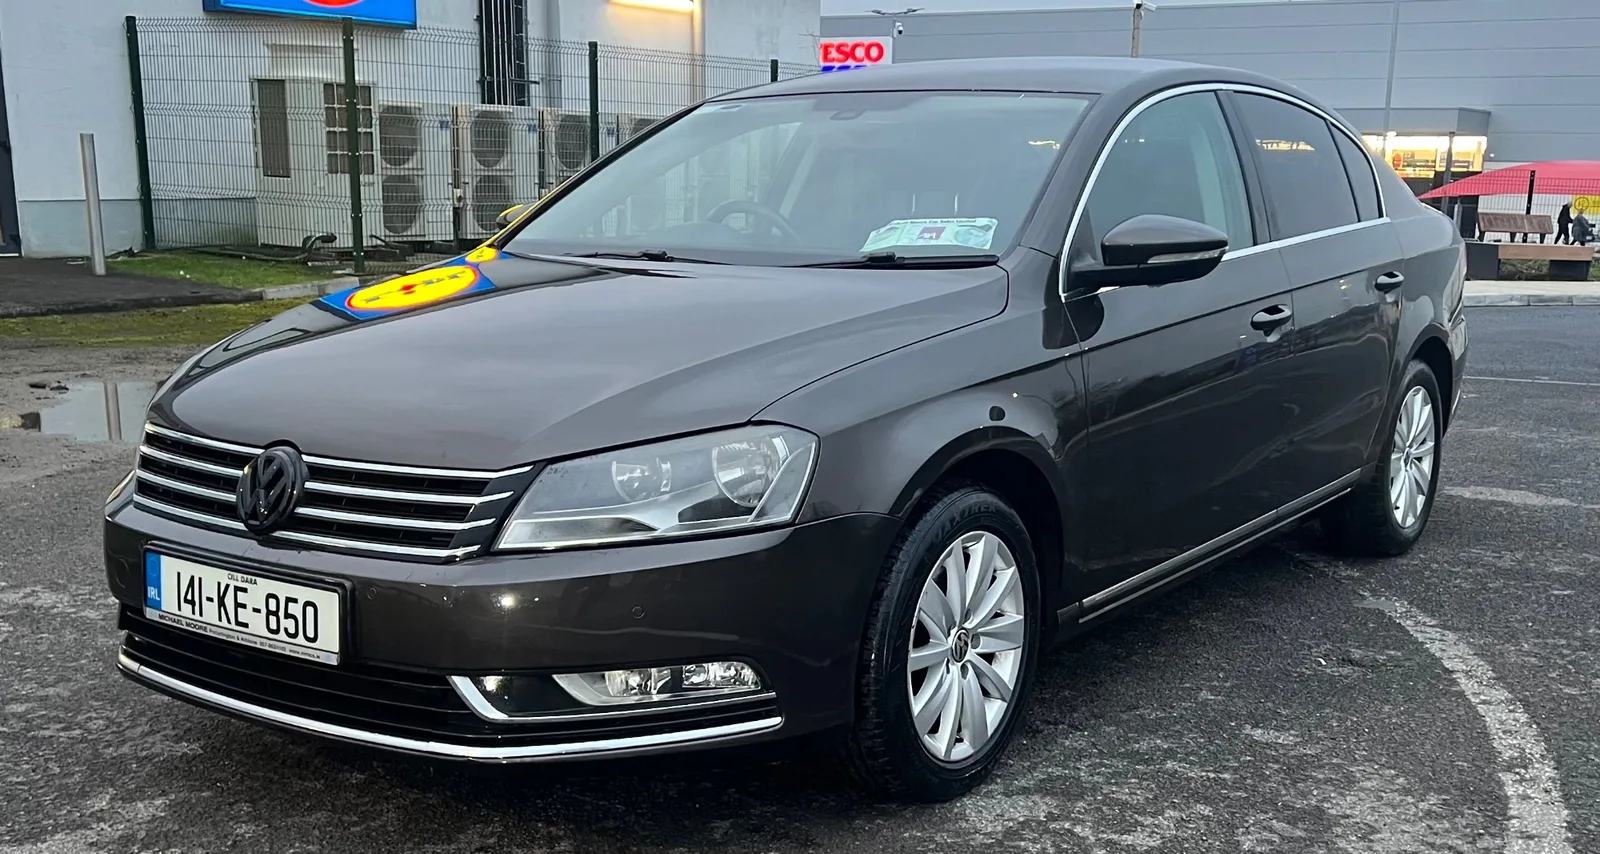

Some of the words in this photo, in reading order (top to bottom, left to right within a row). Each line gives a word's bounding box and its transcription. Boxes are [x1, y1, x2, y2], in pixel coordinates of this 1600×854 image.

[819, 41, 884, 63] ESCO
[240, 575, 258, 586] DARA
[147, 585, 161, 601] IRL
[176, 571, 319, 644] 141-KE-850
[158, 613, 185, 627] MICHAEL
[185, 620, 208, 633] MOORE
